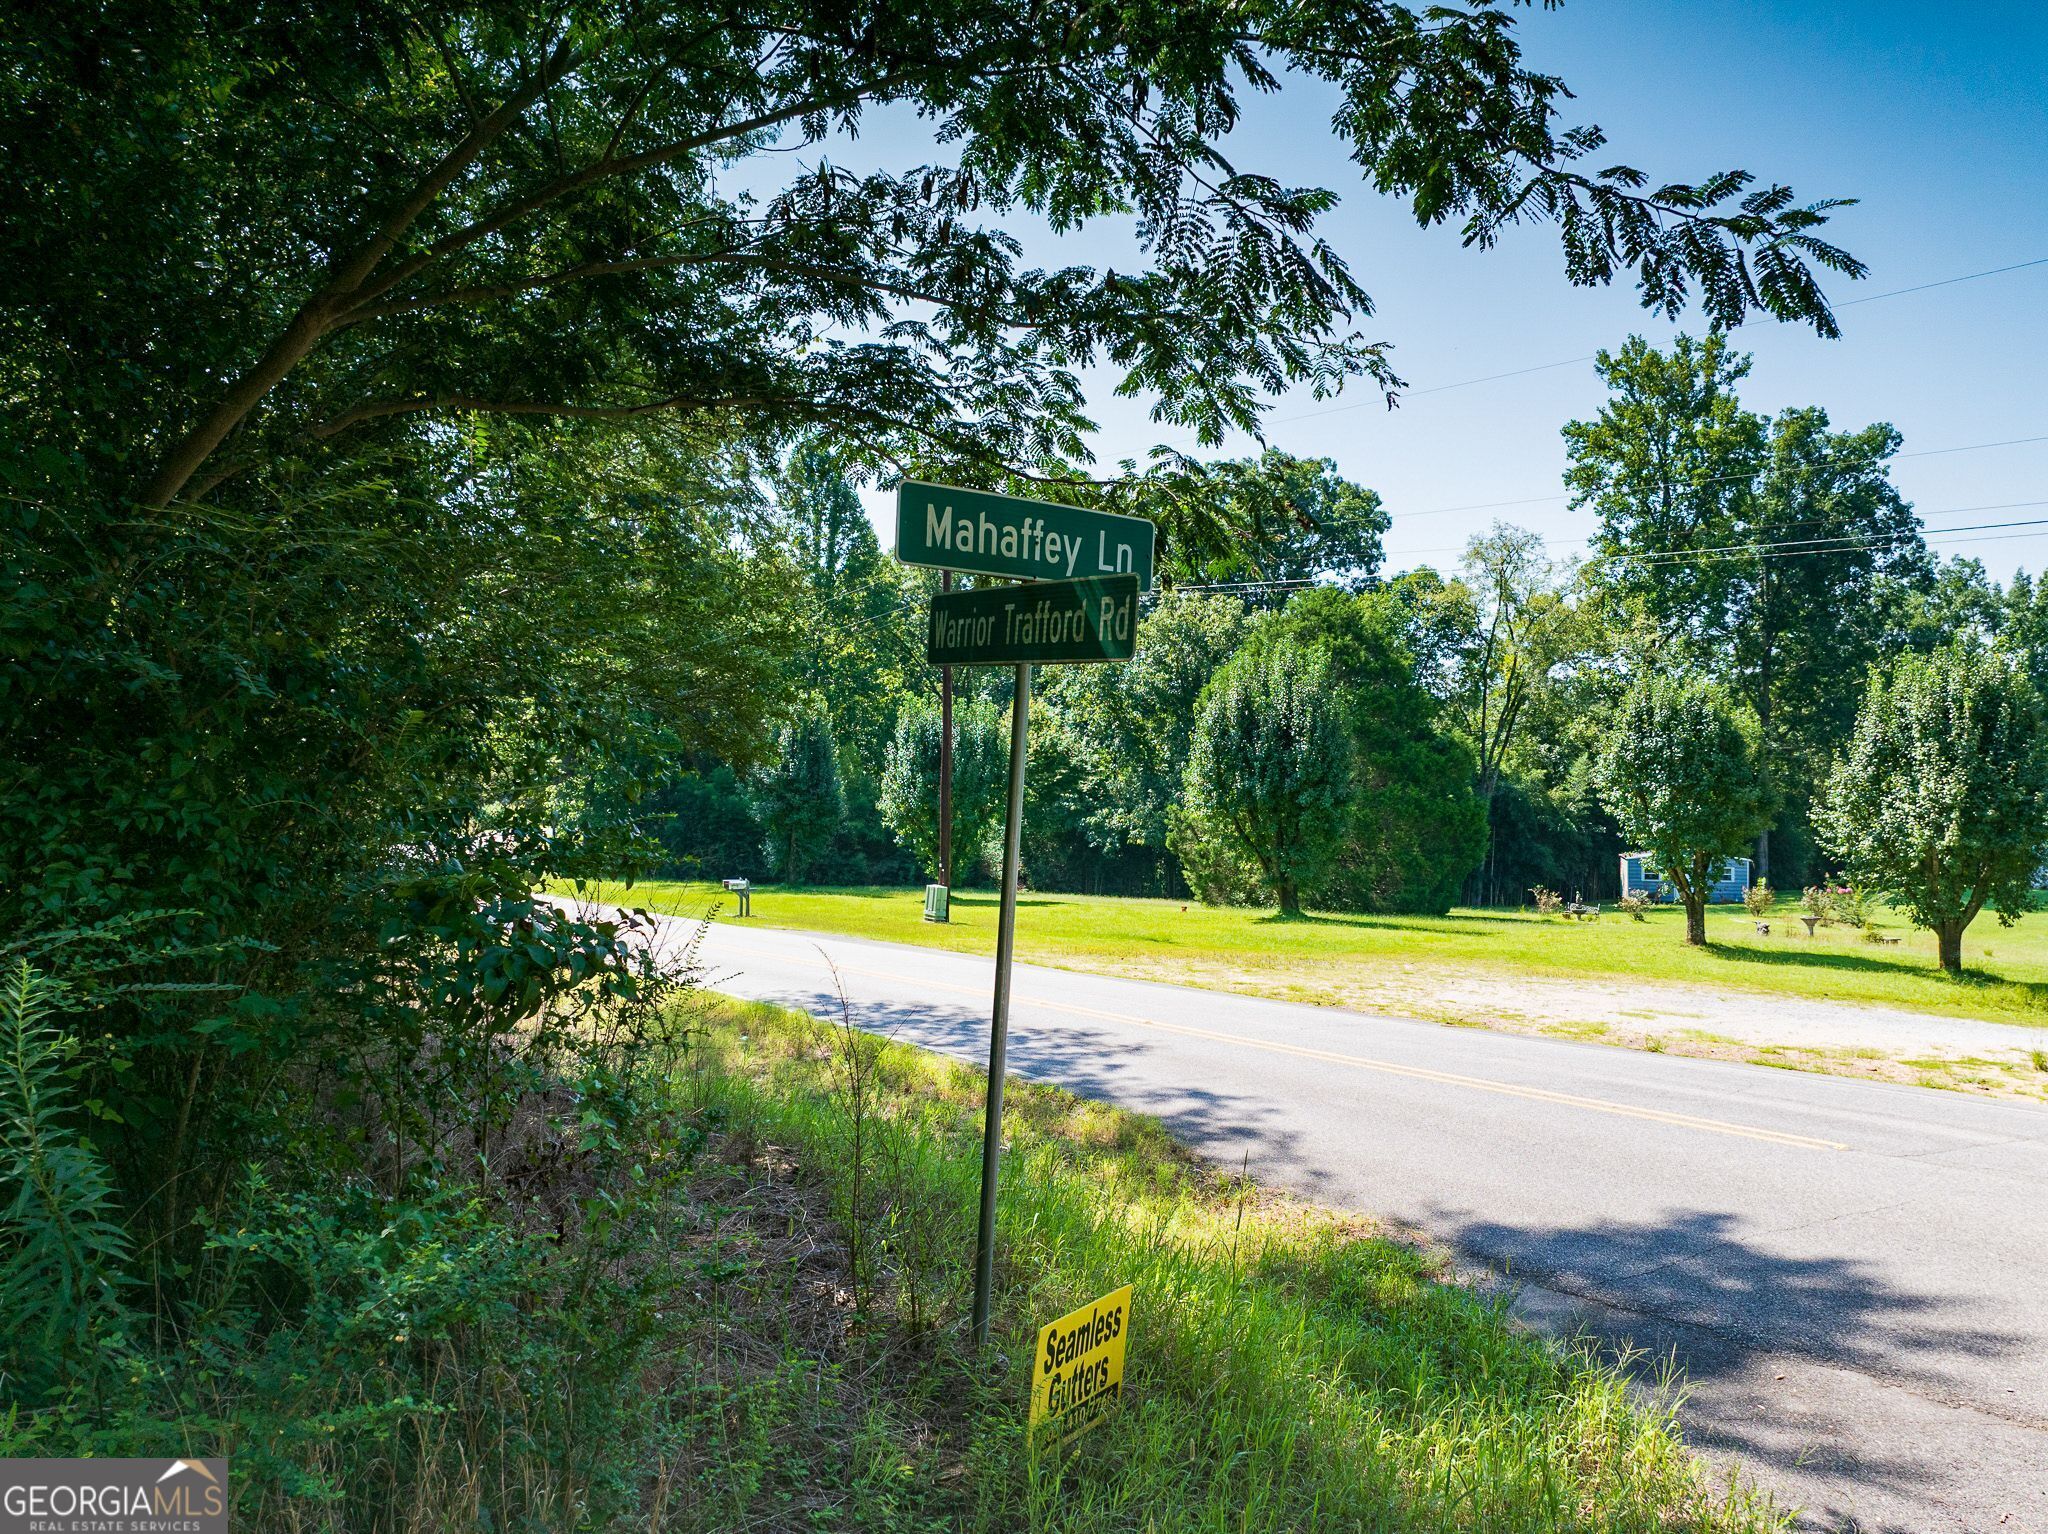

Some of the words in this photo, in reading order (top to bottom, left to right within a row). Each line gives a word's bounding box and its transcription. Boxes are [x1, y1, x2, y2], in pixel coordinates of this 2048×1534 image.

[926, 503, 1082, 577] Mahaffey
[1098, 530, 1133, 573] Ln
[934, 607, 996, 649] Warrior
[1004, 600, 1087, 645] Trafford
[1098, 594, 1131, 641] Rd
[1044, 1306, 1122, 1374] Seamless
[1049, 1356, 1109, 1418] Gutters
